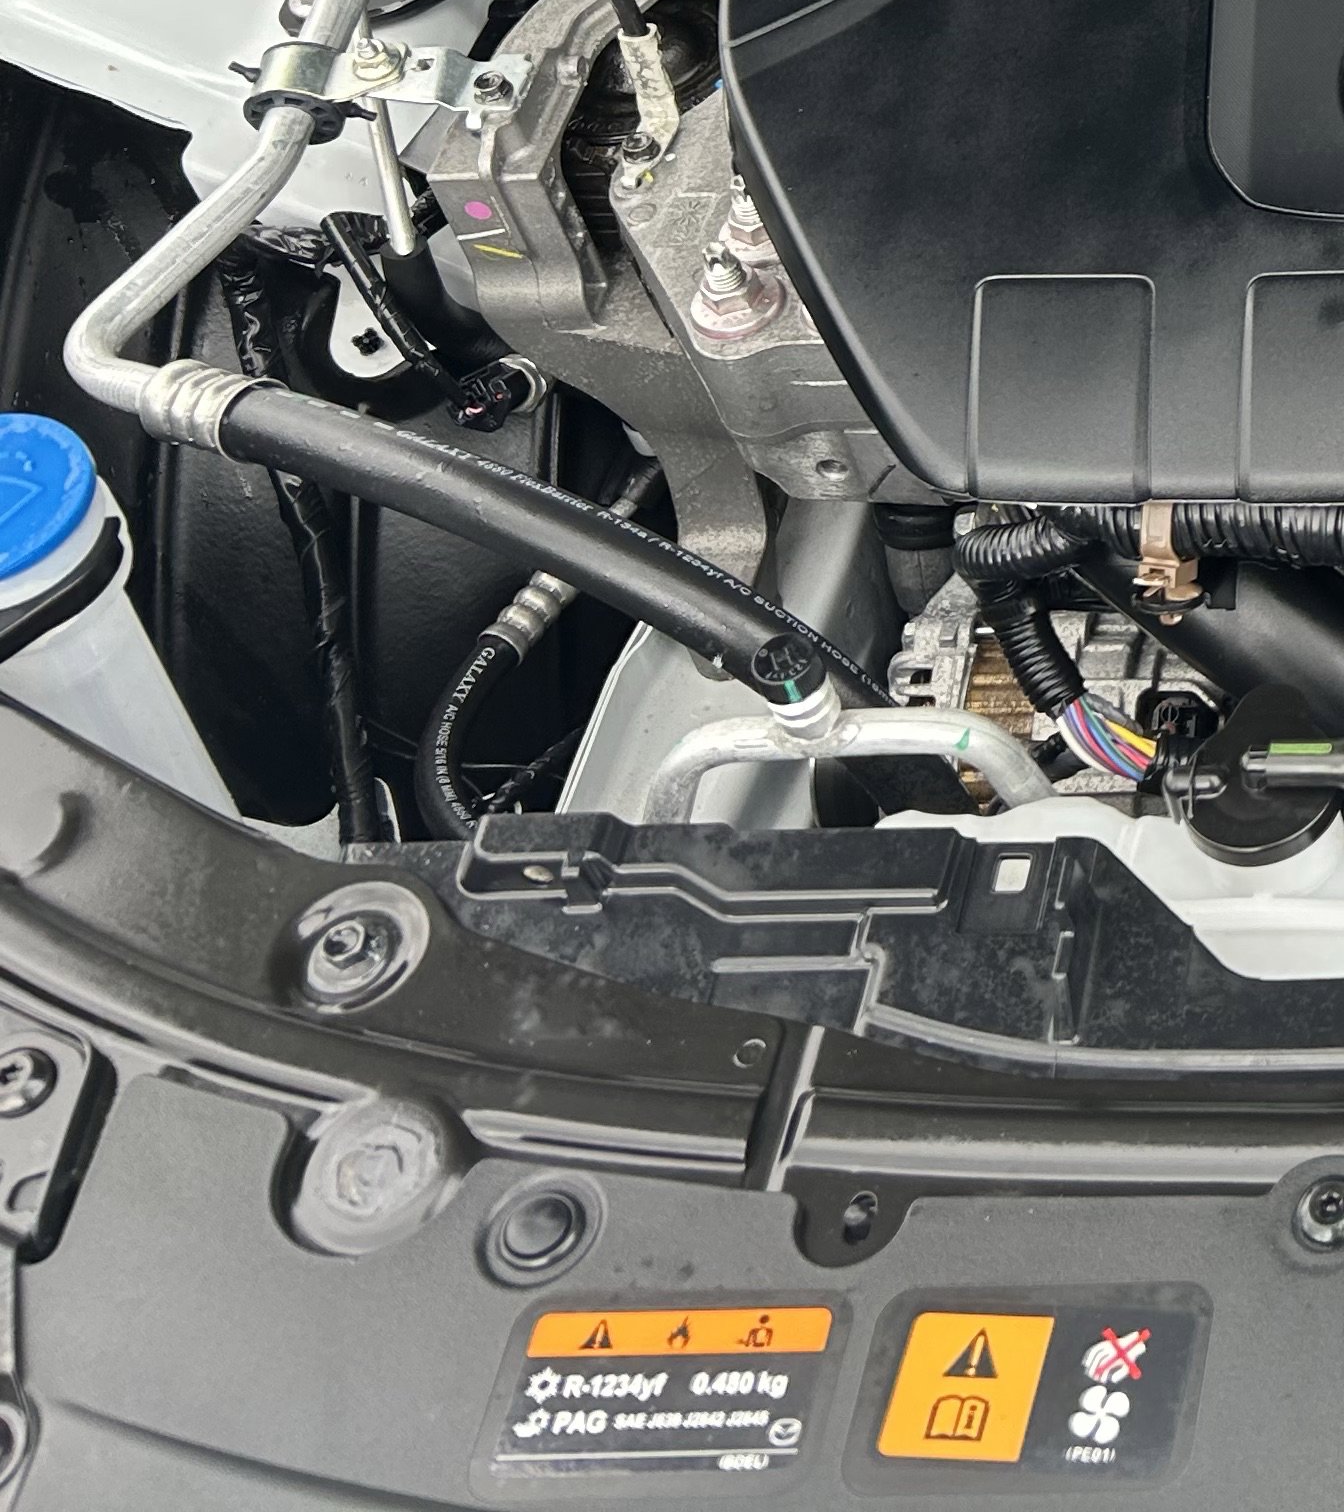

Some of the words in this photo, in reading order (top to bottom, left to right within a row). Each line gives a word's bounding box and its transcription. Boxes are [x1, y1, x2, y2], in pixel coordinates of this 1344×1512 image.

[724, 578, 752, 597] A/C
[754, 595, 818, 643] SUCTION
[821, 641, 860, 675] HOSE
[453, 647, 496, 703] GALAXY
[562, 1372, 669, 1402] R-1234yf
[757, 1370, 789, 1399] kg
[551, 1410, 608, 1435] PAG
